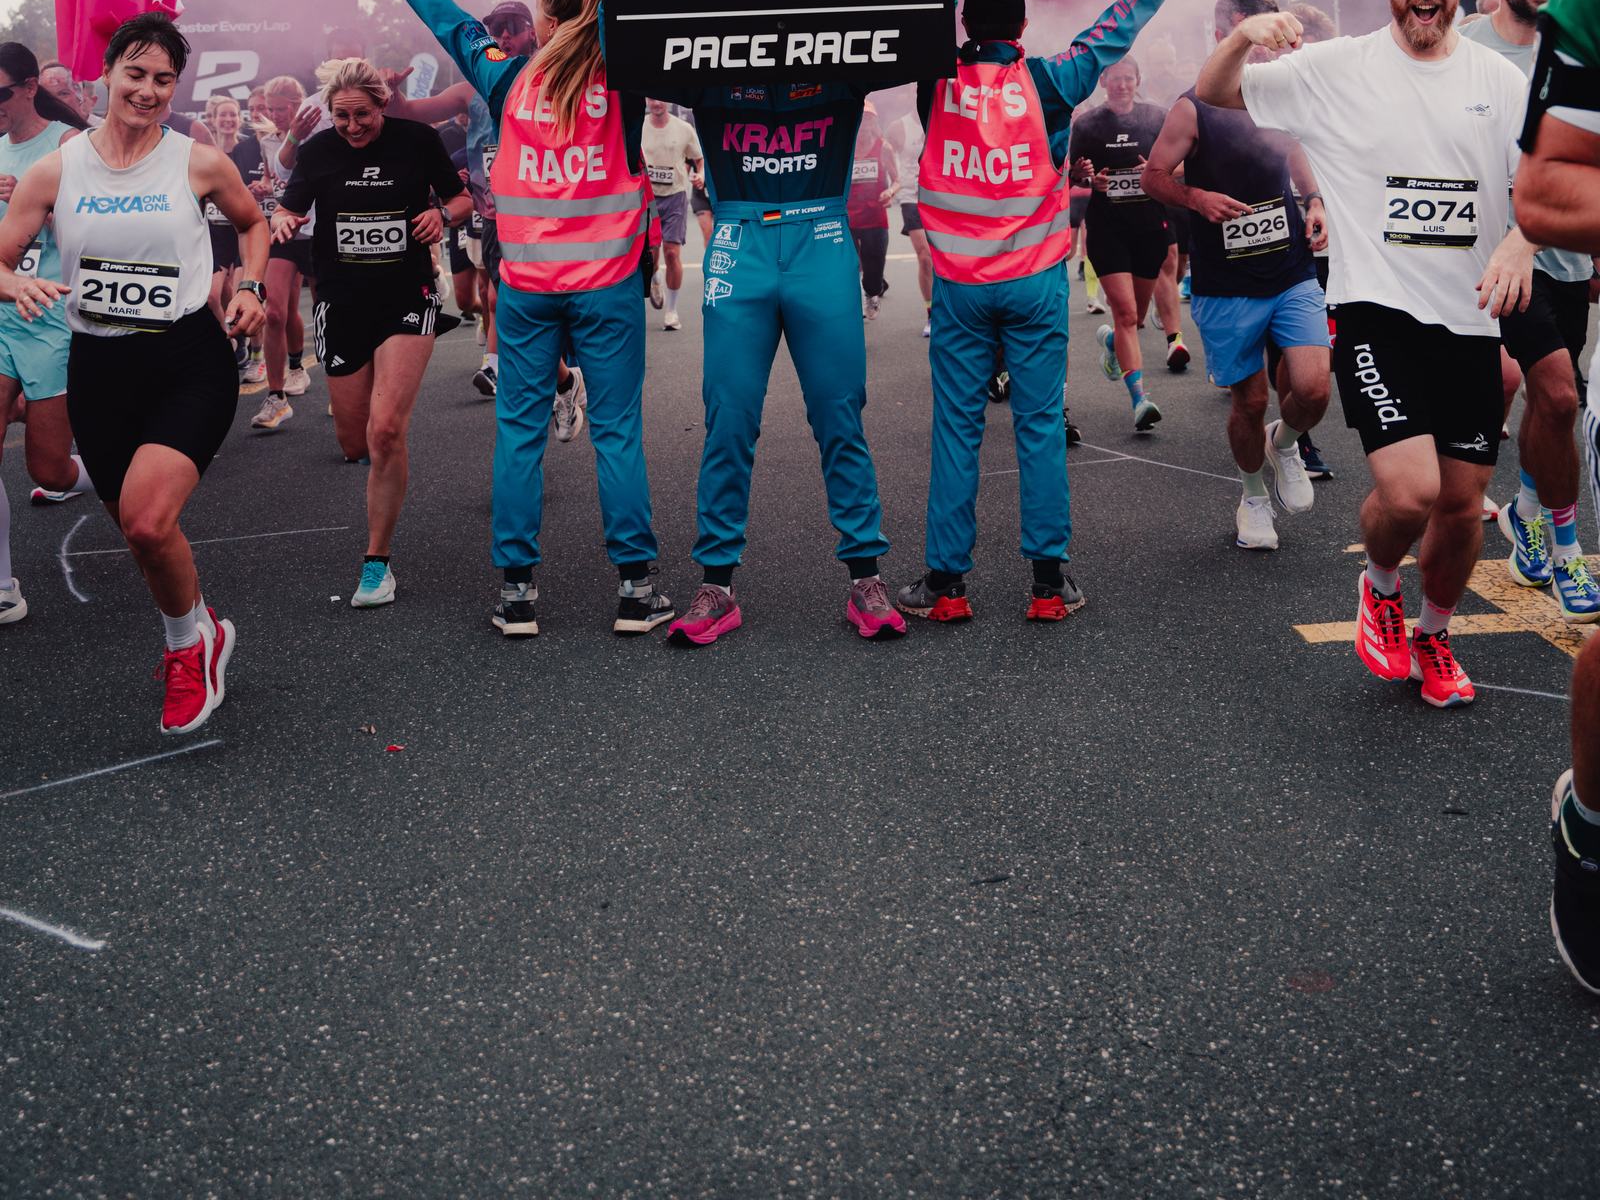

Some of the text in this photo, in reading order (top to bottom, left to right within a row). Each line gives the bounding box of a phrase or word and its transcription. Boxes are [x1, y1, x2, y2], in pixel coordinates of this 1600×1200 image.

[220, 20, 262, 33] Every
[263, 19, 292, 31] Lap
[663, 29, 900, 71] PACE RACE
[515, 83, 608, 123] LES
[943, 78, 1027, 124] LET'S
[722, 117, 834, 154] KRAFT
[517, 143, 607, 184] RACE
[742, 154, 818, 175] SPORTS
[942, 139, 1033, 185] RACE
[1108, 179, 1141, 190] 205
[1416, 181, 1441, 189] PACE
[75, 193, 169, 214] HOKA ONE
[144, 202, 172, 212] ONE
[785, 205, 826, 216] PIT KREW
[1388, 198, 1477, 223] 2074
[339, 227, 404, 246] 2160
[1225, 215, 1286, 240] 2026
[1423, 225, 1446, 233] LUIS
[1247, 236, 1271, 245] LUKAS
[110, 263, 135, 273] PACE
[135, 266, 160, 274] RACE
[82, 278, 173, 309] 2106
[108, 305, 142, 316] MARIE
[1354, 343, 1408, 431] rappid.
